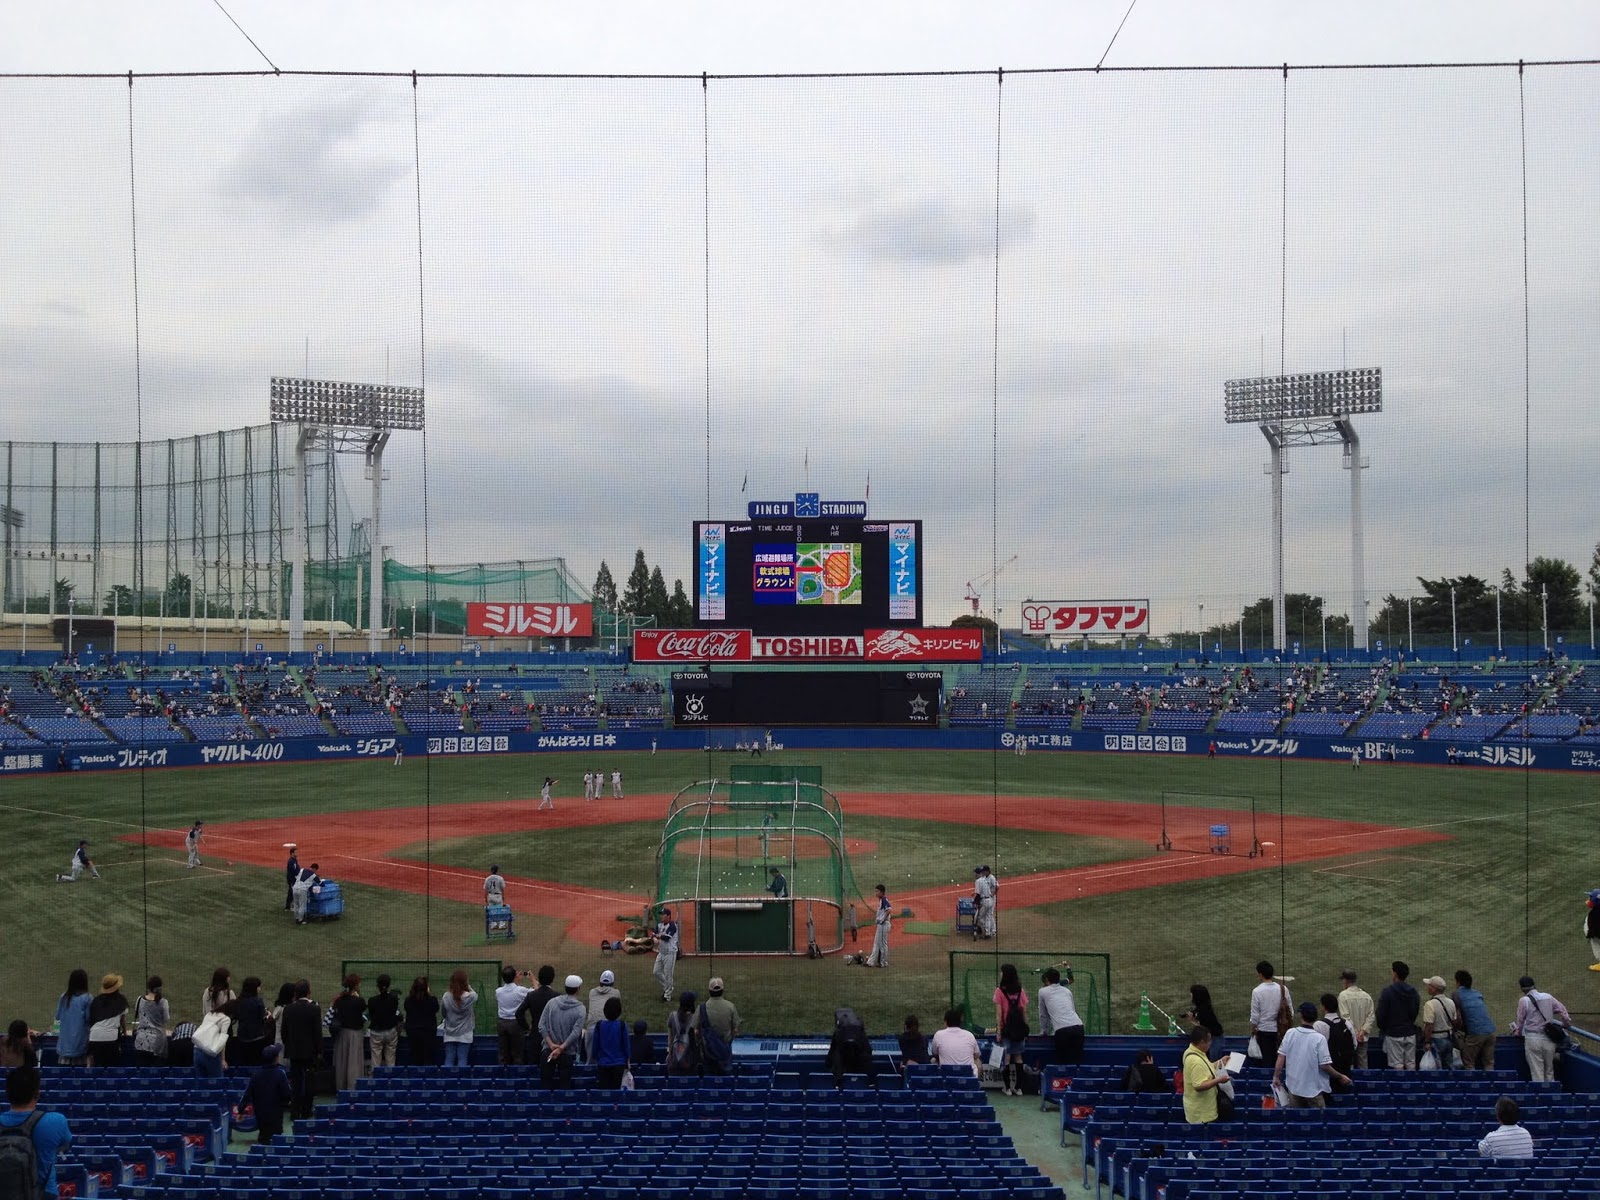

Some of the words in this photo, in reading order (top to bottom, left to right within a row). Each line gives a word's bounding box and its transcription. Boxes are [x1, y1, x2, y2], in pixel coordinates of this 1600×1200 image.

[755, 504, 788, 515] JINGU
[822, 504, 865, 515] STADIUM
[705, 543, 720, 596] マイナビ
[895, 542, 910, 596] マイナビ
[756, 578, 795, 587] グラウンド
[482, 605, 578, 635] ミルミル
[1052, 606, 1147, 630] タフマン
[641, 631, 658, 639] Enjoy
[656, 631, 741, 657] Coca-Cola
[756, 638, 860, 656] TOSHIBA
[922, 638, 980, 650] キリンビール
[317, 744, 351, 752] Yakult
[356, 738, 396, 755] ジョア
[427, 736, 509, 753] 明治記念館
[1104, 735, 1187, 751] 明治記念館
[1217, 741, 1249, 750] Yakult
[1250, 738, 1299, 755] ソフール
[1330, 745, 1364, 753] Yakut
[79, 754, 116, 763] Yakult
[118, 748, 168, 768] プレティオ
[201, 743, 284, 763] ヤクルト400
[1445, 749, 1480, 758] Ykult
[1481, 746, 1536, 766] ミルミル
[1571, 750, 1596, 759] ヤクルト
[0, 754, 43, 770] 整腸薬
